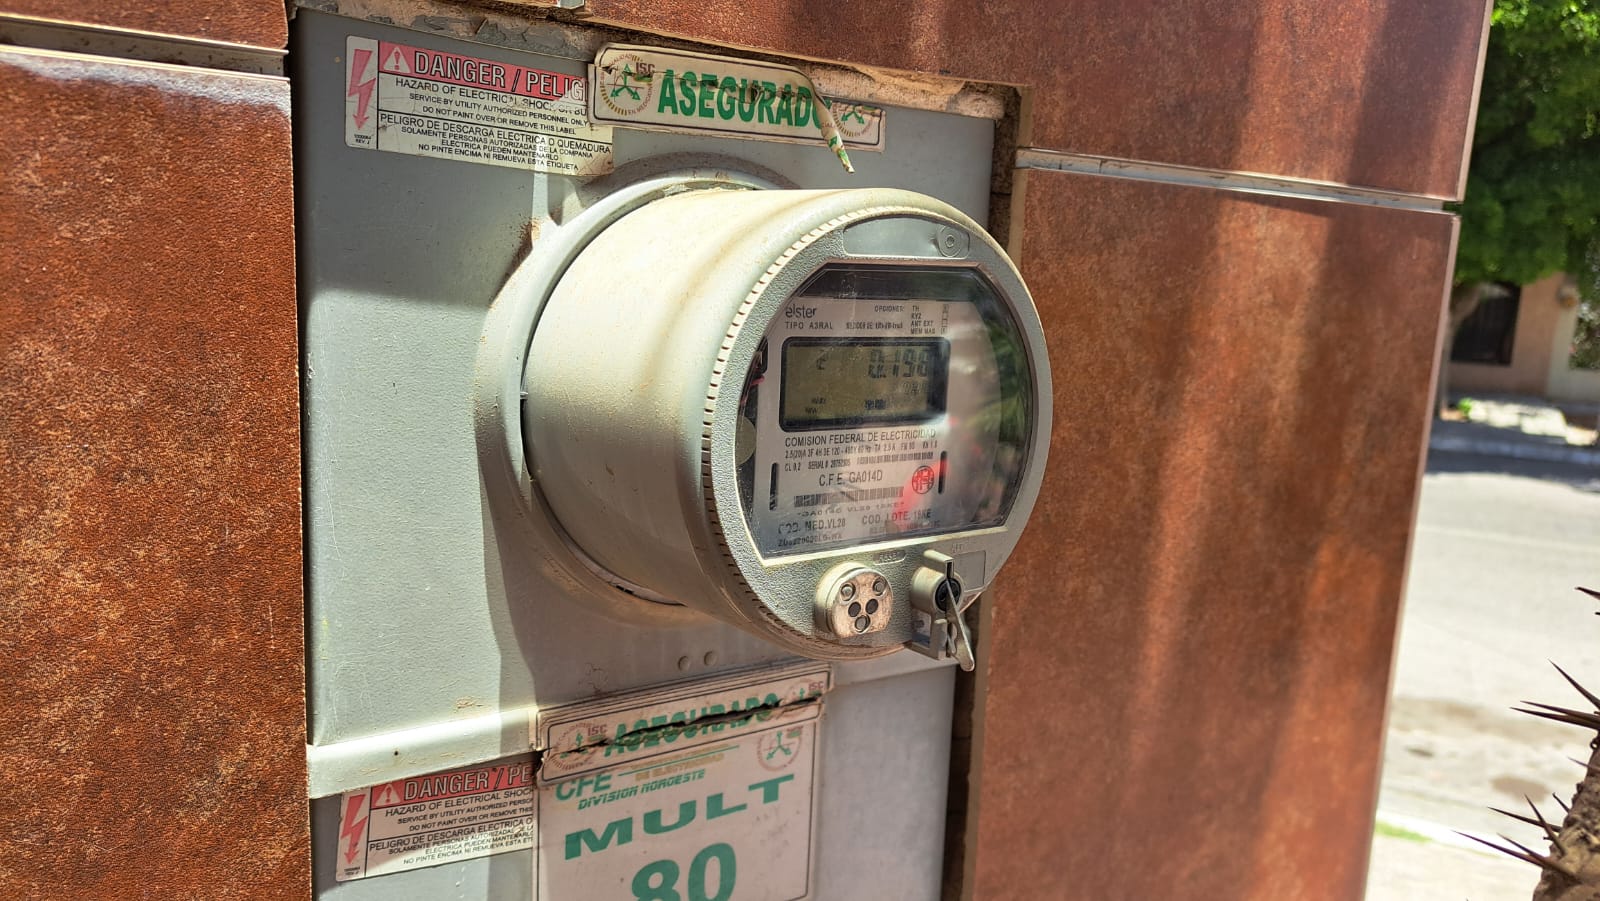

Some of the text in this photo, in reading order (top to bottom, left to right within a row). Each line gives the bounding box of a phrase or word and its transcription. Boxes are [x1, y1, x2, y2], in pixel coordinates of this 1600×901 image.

[396, 77, 439, 92] HAZARD
[442, 85, 457, 95] OF
[414, 50, 588, 102] DANGER / PELIG
[409, 93, 588, 127] SERVICE BY UTILITY AUTHORIZED PERSONNEL ONLY
[435, 108, 452, 116] NOT
[453, 110, 474, 120] PAINT
[509, 118, 540, 130] REMOVE
[540, 124, 555, 132] THIS
[556, 126, 577, 135] LABEL
[380, 114, 611, 154] PELIGRO DE DESCARGA ELECTRICA O QUEMADURA
[401, 126, 447, 139] SOLAMENTE
[448, 132, 487, 144] PERSONAS
[489, 137, 537, 150] AUTORIZADAS
[538, 145, 548, 153] DE
[559, 148, 593, 159] COMPANIA
[441, 139, 481, 150] ELECTRICA
[482, 144, 512, 154] PUEDEN
[418, 143, 430, 151] NO
[431, 145, 453, 154] PINTE
[454, 148, 483, 158] ENCIMA
[492, 153, 526, 164] REMUEVA
[527, 157, 545, 166] ESTA
[546, 160, 579, 171] ETIQUETA
[785, 303, 817, 319] elster
[784, 321, 804, 330] TIPO
[784, 428, 936, 448] COMISION FEDERAL DE ELECTRICIDAD
[587, 723, 608, 737] ISC
[403, 770, 489, 801] DANGER
[493, 767, 505, 790] /
[555, 773, 613, 801] CFE
[578, 768, 705, 811] DIVISION NOROESTE
[385, 803, 427, 817] HAZARD
[428, 801, 443, 810] OF
[444, 792, 501, 808] ELECTRICAL
[397, 814, 428, 824] SERVICE
[429, 812, 440, 820] BY
[440, 808, 466, 818] UTILITY
[466, 801, 509, 814] AUTHORIZED
[564, 773, 795, 861] MULT
[409, 824, 421, 832] DO
[421, 821, 436, 830] NOT
[437, 818, 458, 828] PAINT
[459, 815, 478, 824] OVER
[489, 808, 517, 818] REMOVE
[369, 837, 411, 852] PELIGRO
[412, 834, 426, 845] DE
[427, 826, 475, 842] DESCARGA
[477, 818, 524, 833] ELECTRICA
[388, 842, 432, 855] SOLAMENTE
[432, 836, 470, 847] PERSONAS
[425, 844, 462, 855] ELECTRICA
[464, 839, 492, 848] PUEDEN
[403, 857, 415, 865] NO
[415, 852, 437, 863] PINTE
[437, 848, 463, 859] ENCIMA
[472, 842, 504, 852] REMUEVA
[505, 838, 522, 846] ESTA
[631, 842, 737, 901] 80
